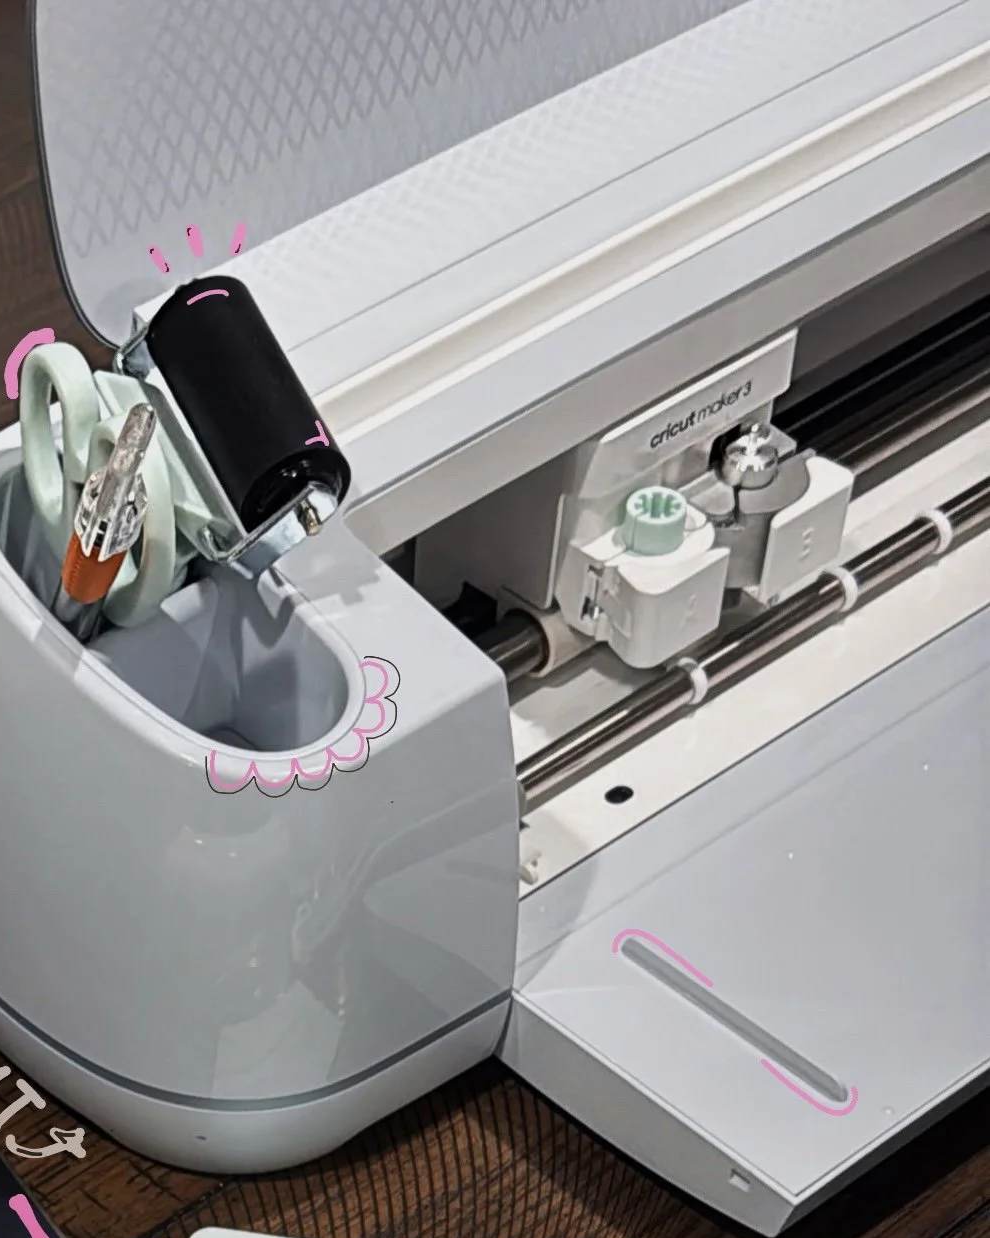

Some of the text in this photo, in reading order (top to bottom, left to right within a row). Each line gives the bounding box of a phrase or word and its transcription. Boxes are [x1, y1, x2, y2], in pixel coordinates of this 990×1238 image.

[650, 379, 752, 449] cricut maker 3
